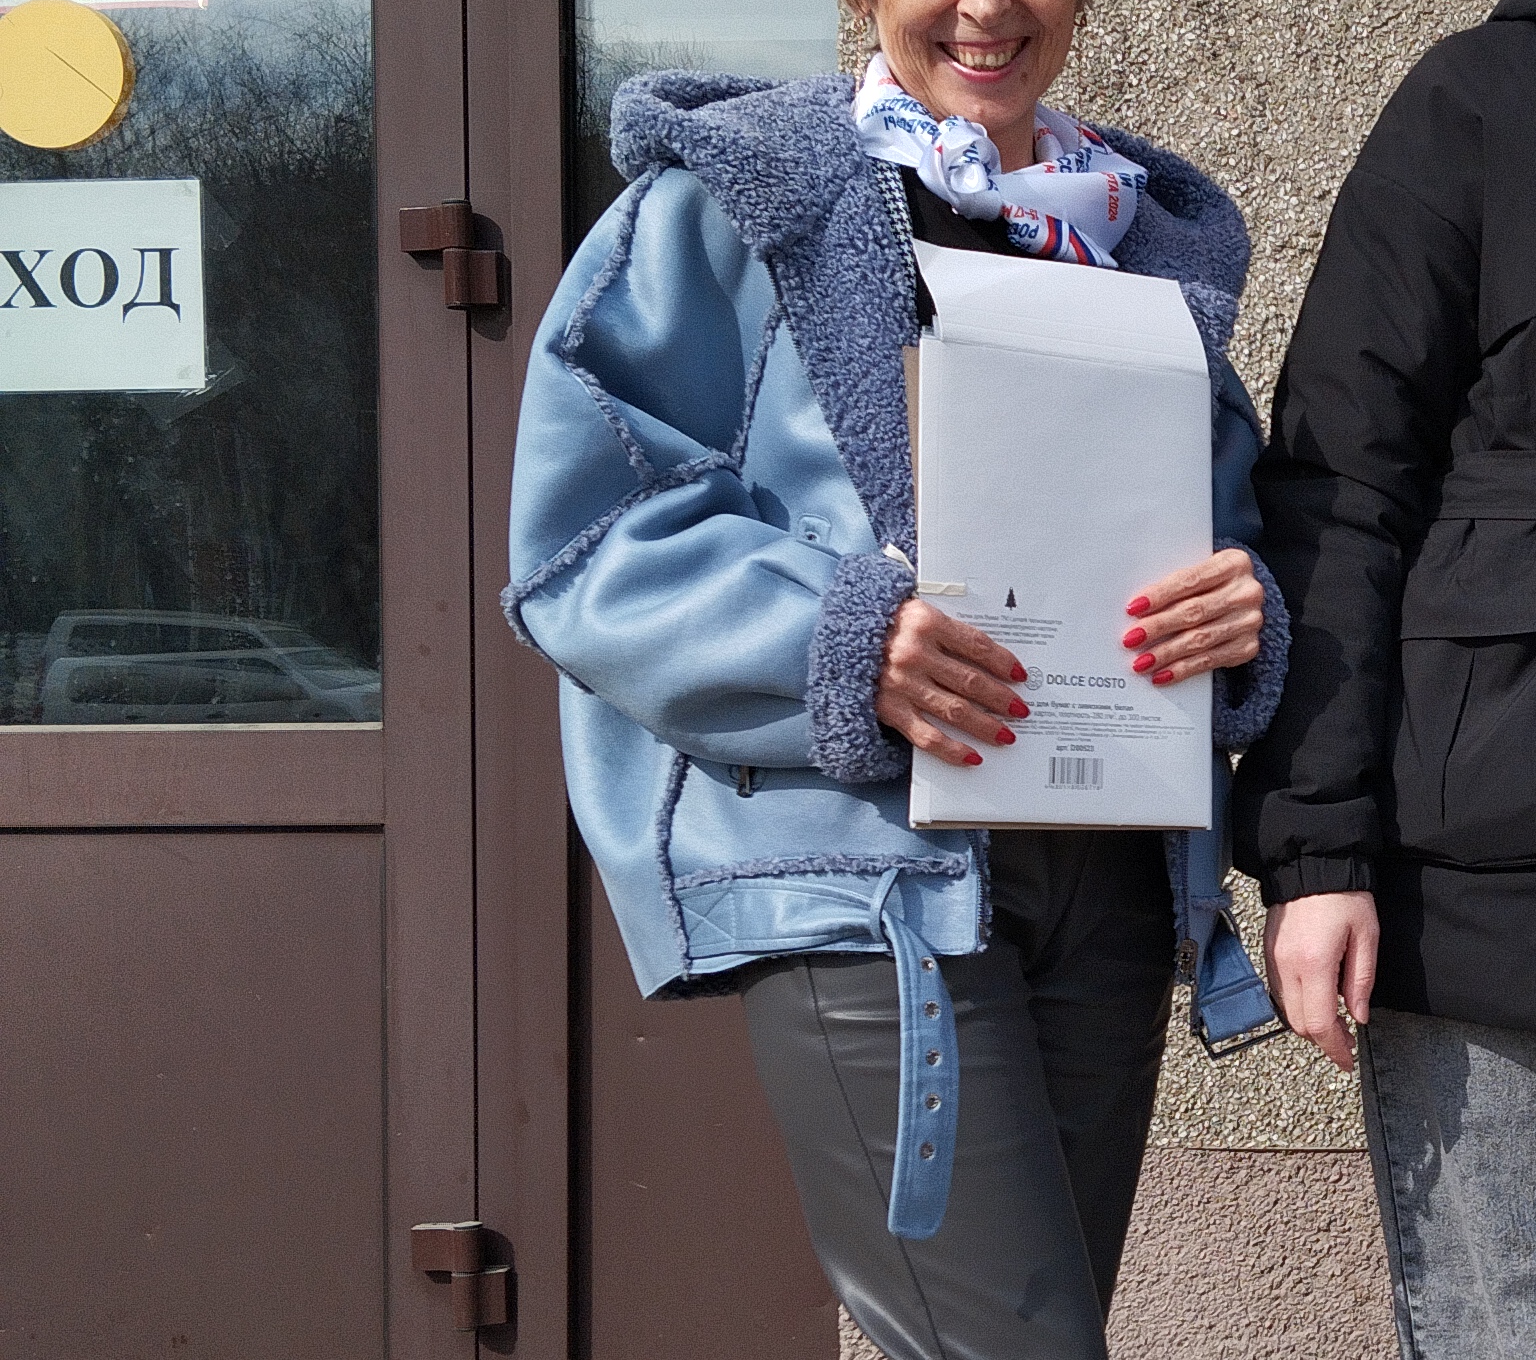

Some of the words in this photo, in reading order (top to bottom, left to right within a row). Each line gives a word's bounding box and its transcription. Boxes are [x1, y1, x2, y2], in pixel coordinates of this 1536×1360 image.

[0, 247, 181, 323] ХОД
[1046, 674, 1085, 687] DOLCE
[1088, 677, 1126, 689] COSTO
